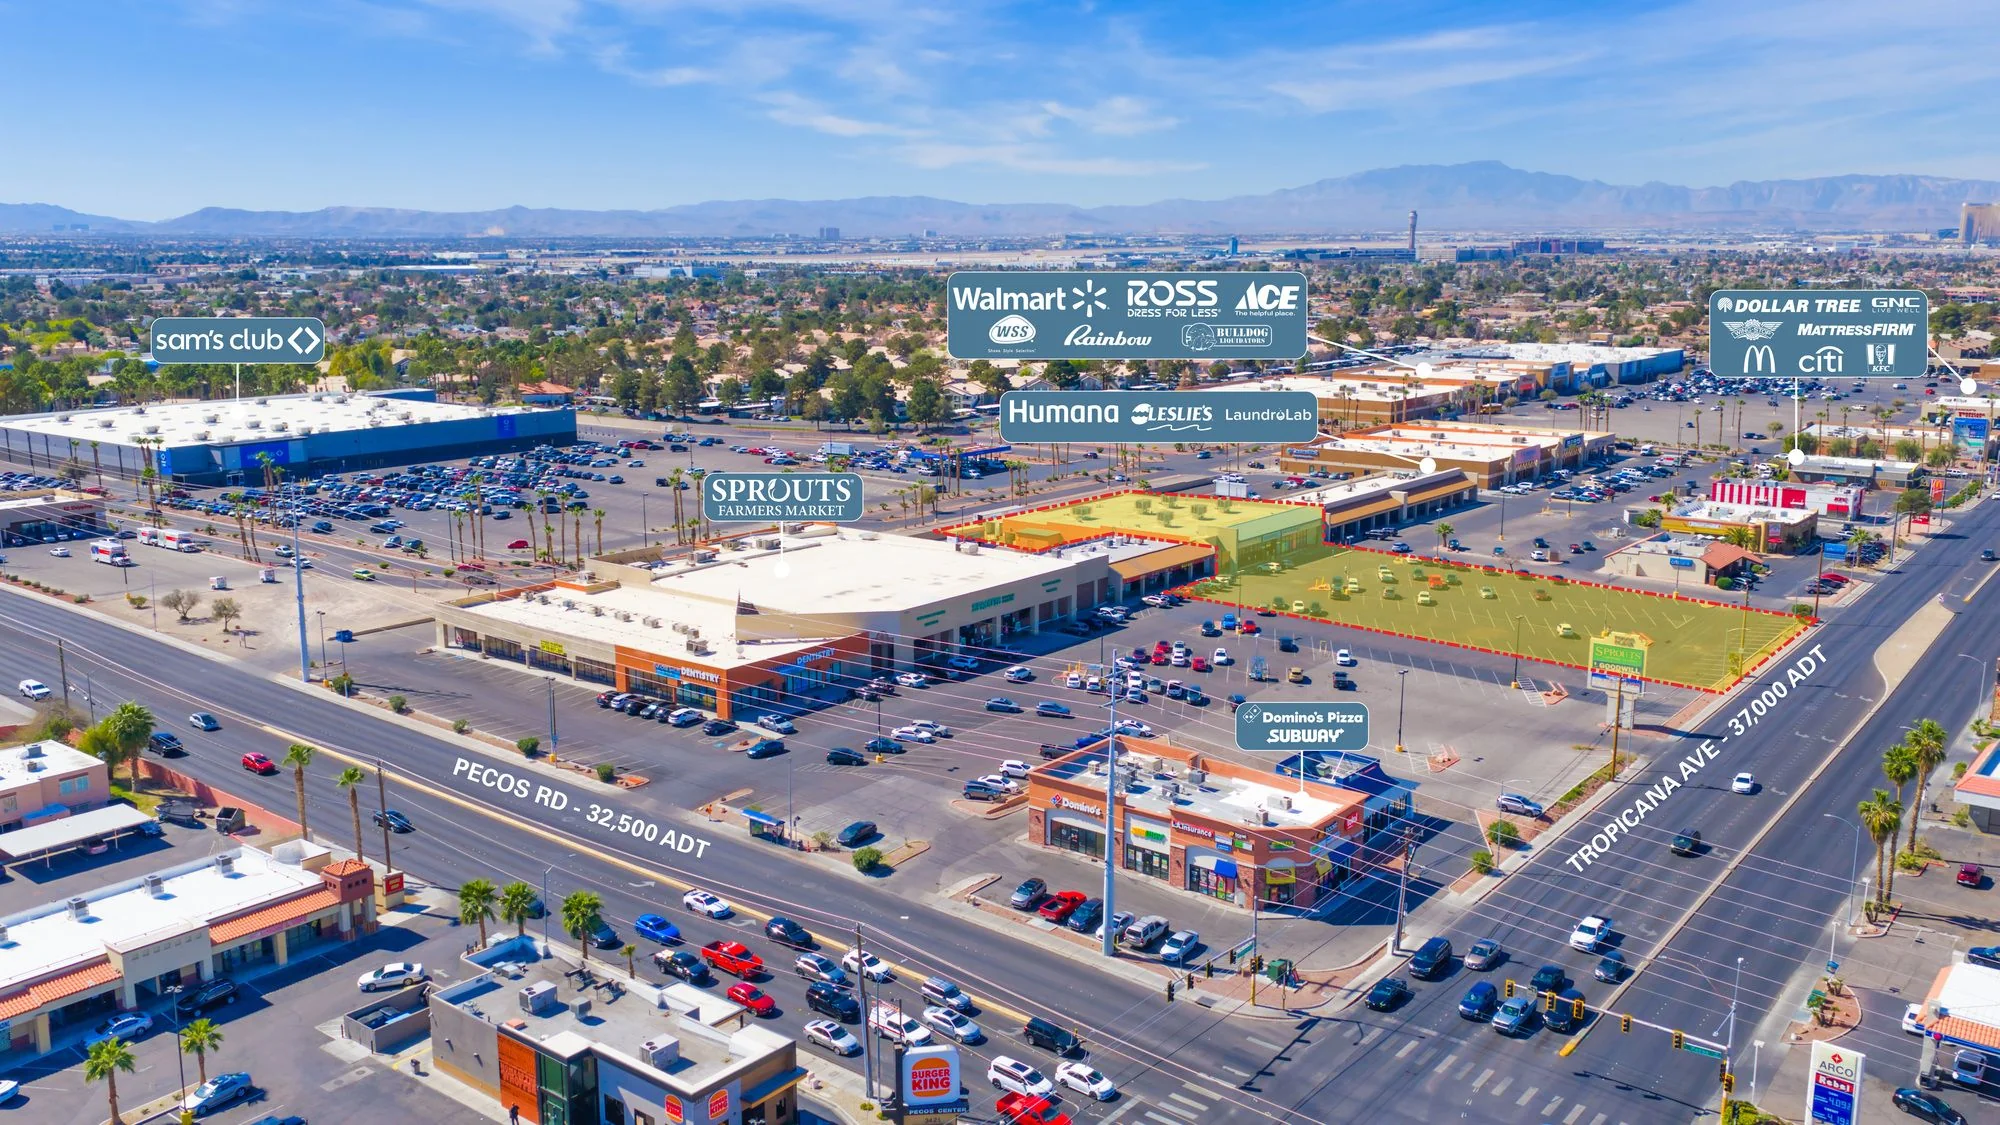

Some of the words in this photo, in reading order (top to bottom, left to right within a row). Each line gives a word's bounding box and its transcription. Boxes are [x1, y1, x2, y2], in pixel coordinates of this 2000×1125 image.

[796, 648, 835, 664] DENTISTRY
[680, 666, 720, 683] DENTISTRY
[1062, 797, 1103, 817] Domino's
[912, 1068, 951, 1079] BURGER
[1819, 1060, 1854, 1078] ARCO
[912, 1077, 951, 1091] KING
[1818, 1076, 1851, 1093] Rebel
